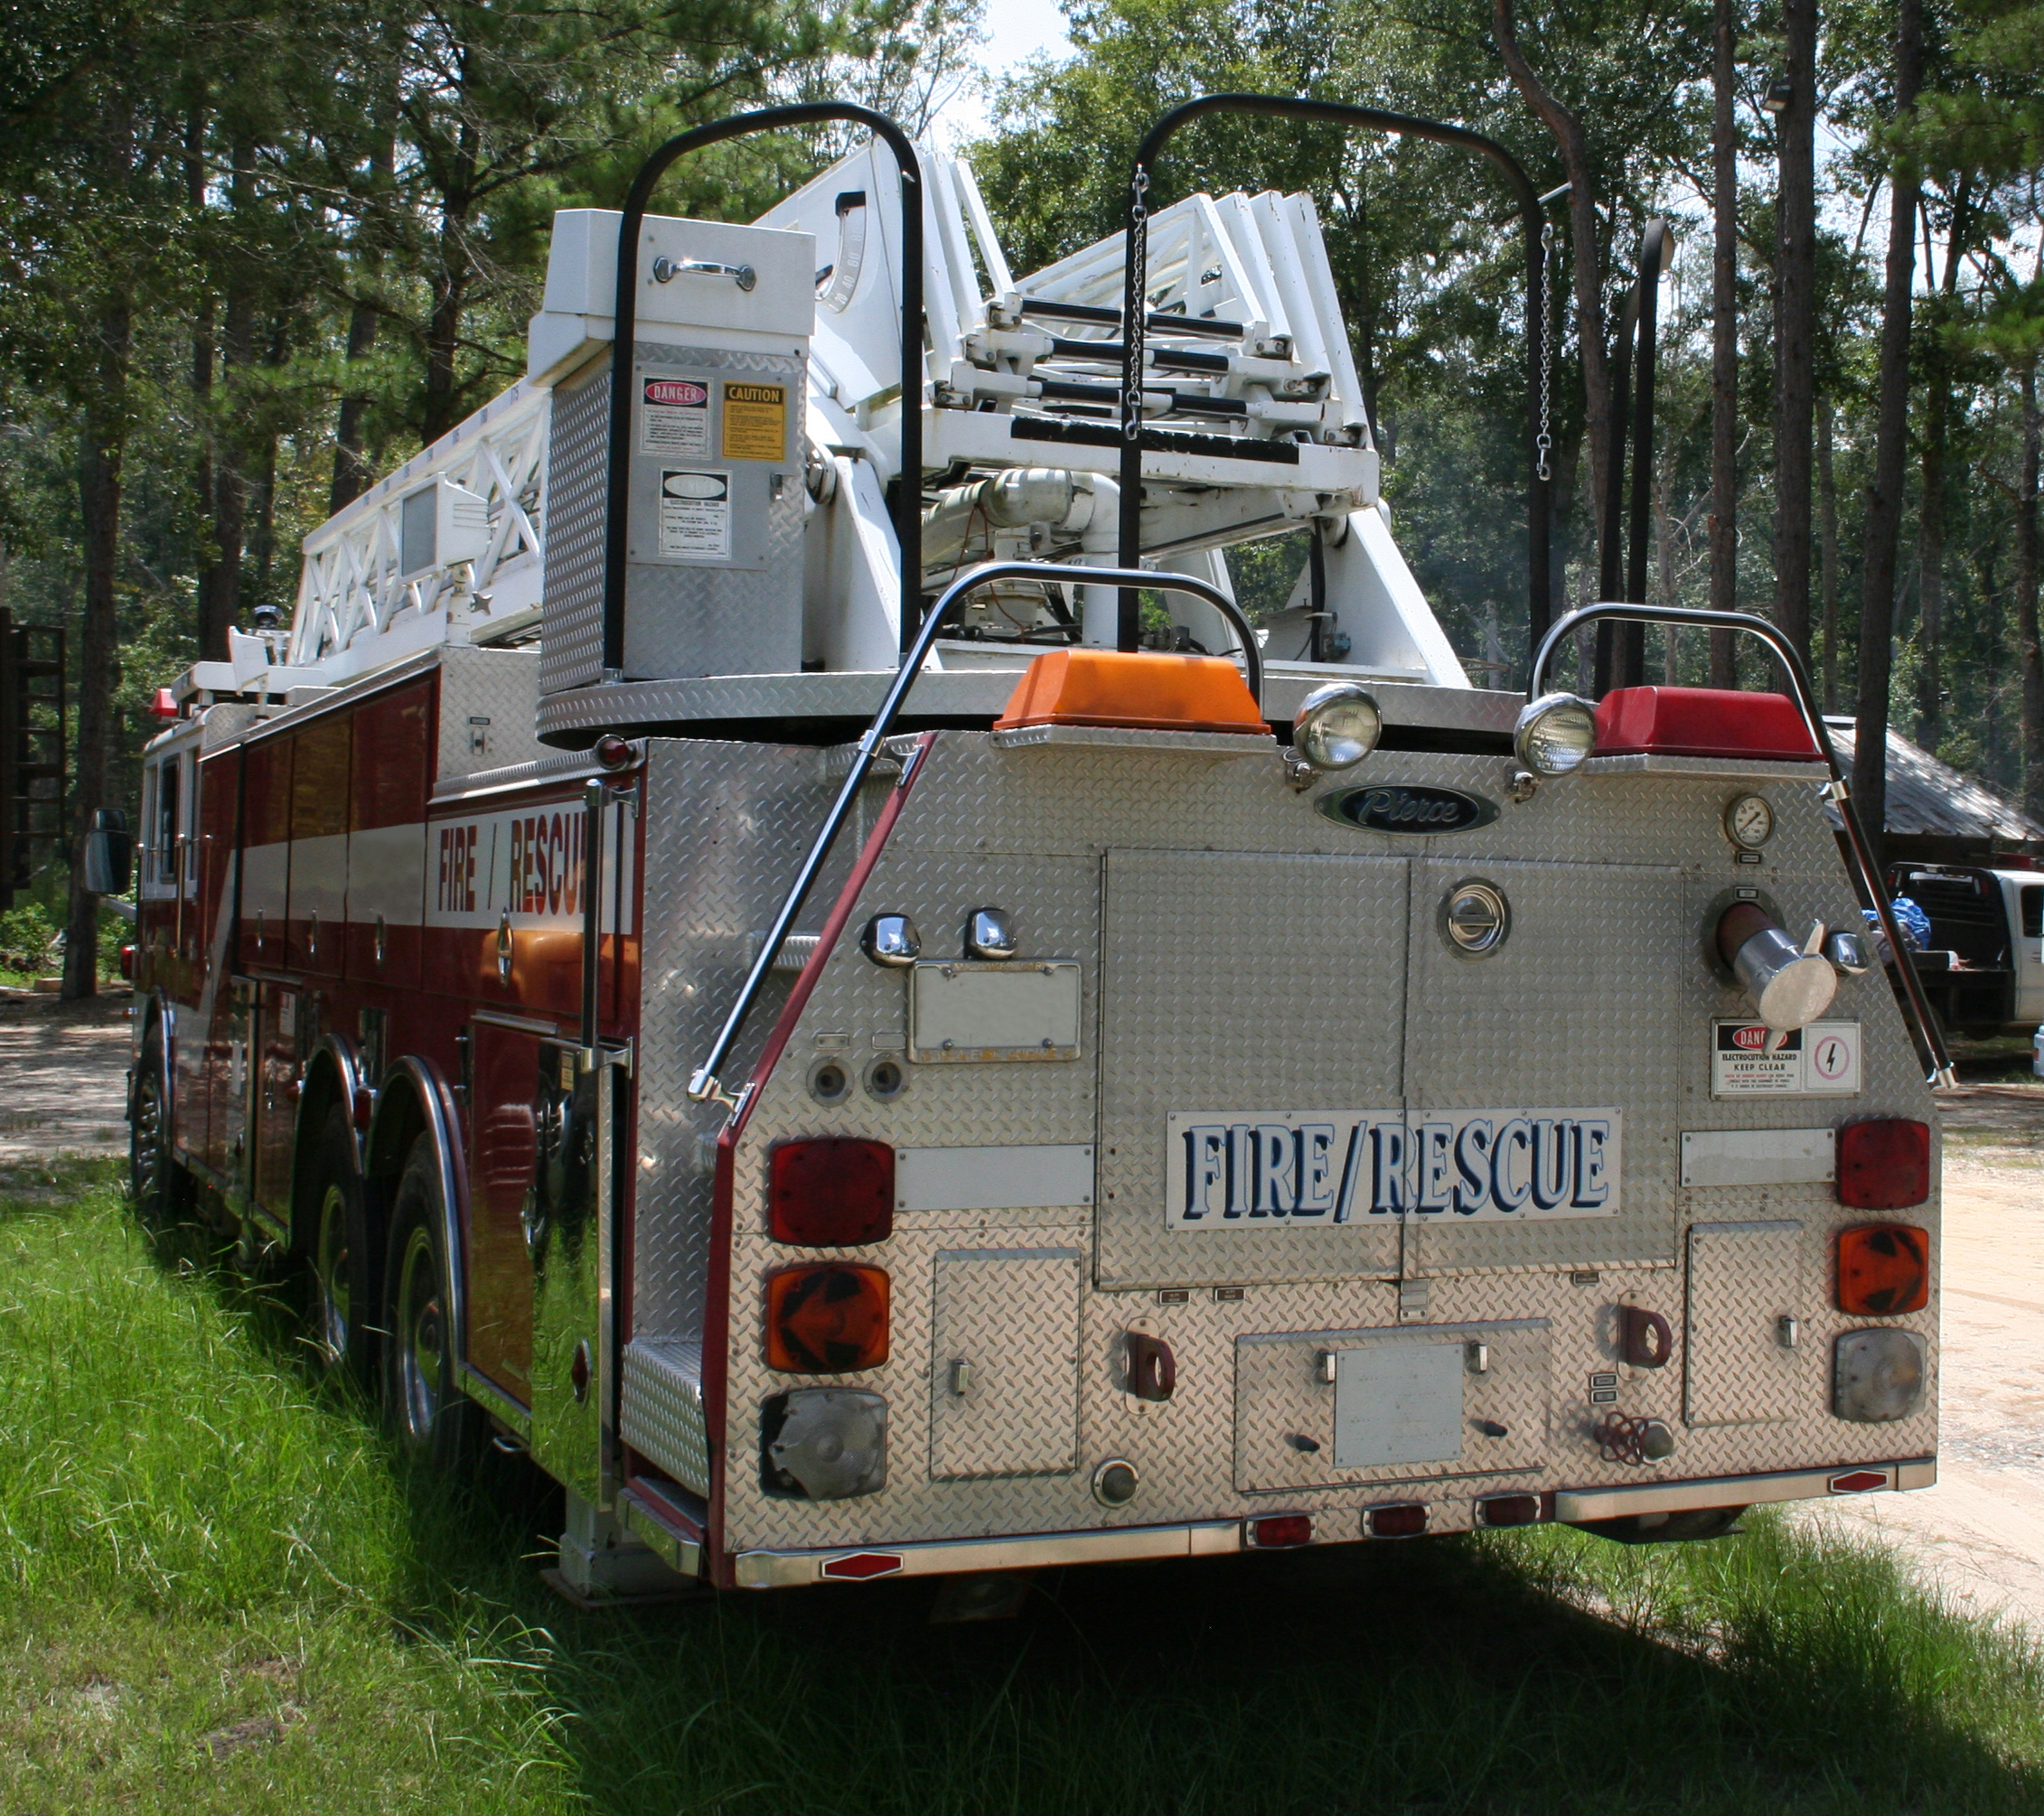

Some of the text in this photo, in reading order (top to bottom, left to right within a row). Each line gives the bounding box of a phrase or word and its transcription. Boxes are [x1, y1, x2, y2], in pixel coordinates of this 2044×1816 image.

[842, 275, 856, 288] 40
[834, 293, 849, 304] 20
[653, 385, 698, 401] DANGER
[728, 387, 780, 402] CAUTION
[1357, 789, 1461, 826] Pierce
[439, 825, 477, 912] FIRE
[1740, 1030, 1765, 1045] DAN
[1734, 1063, 1786, 1072] KEEP CLEAR
[1182, 1119, 1609, 1224] FIRE/RESCUE
